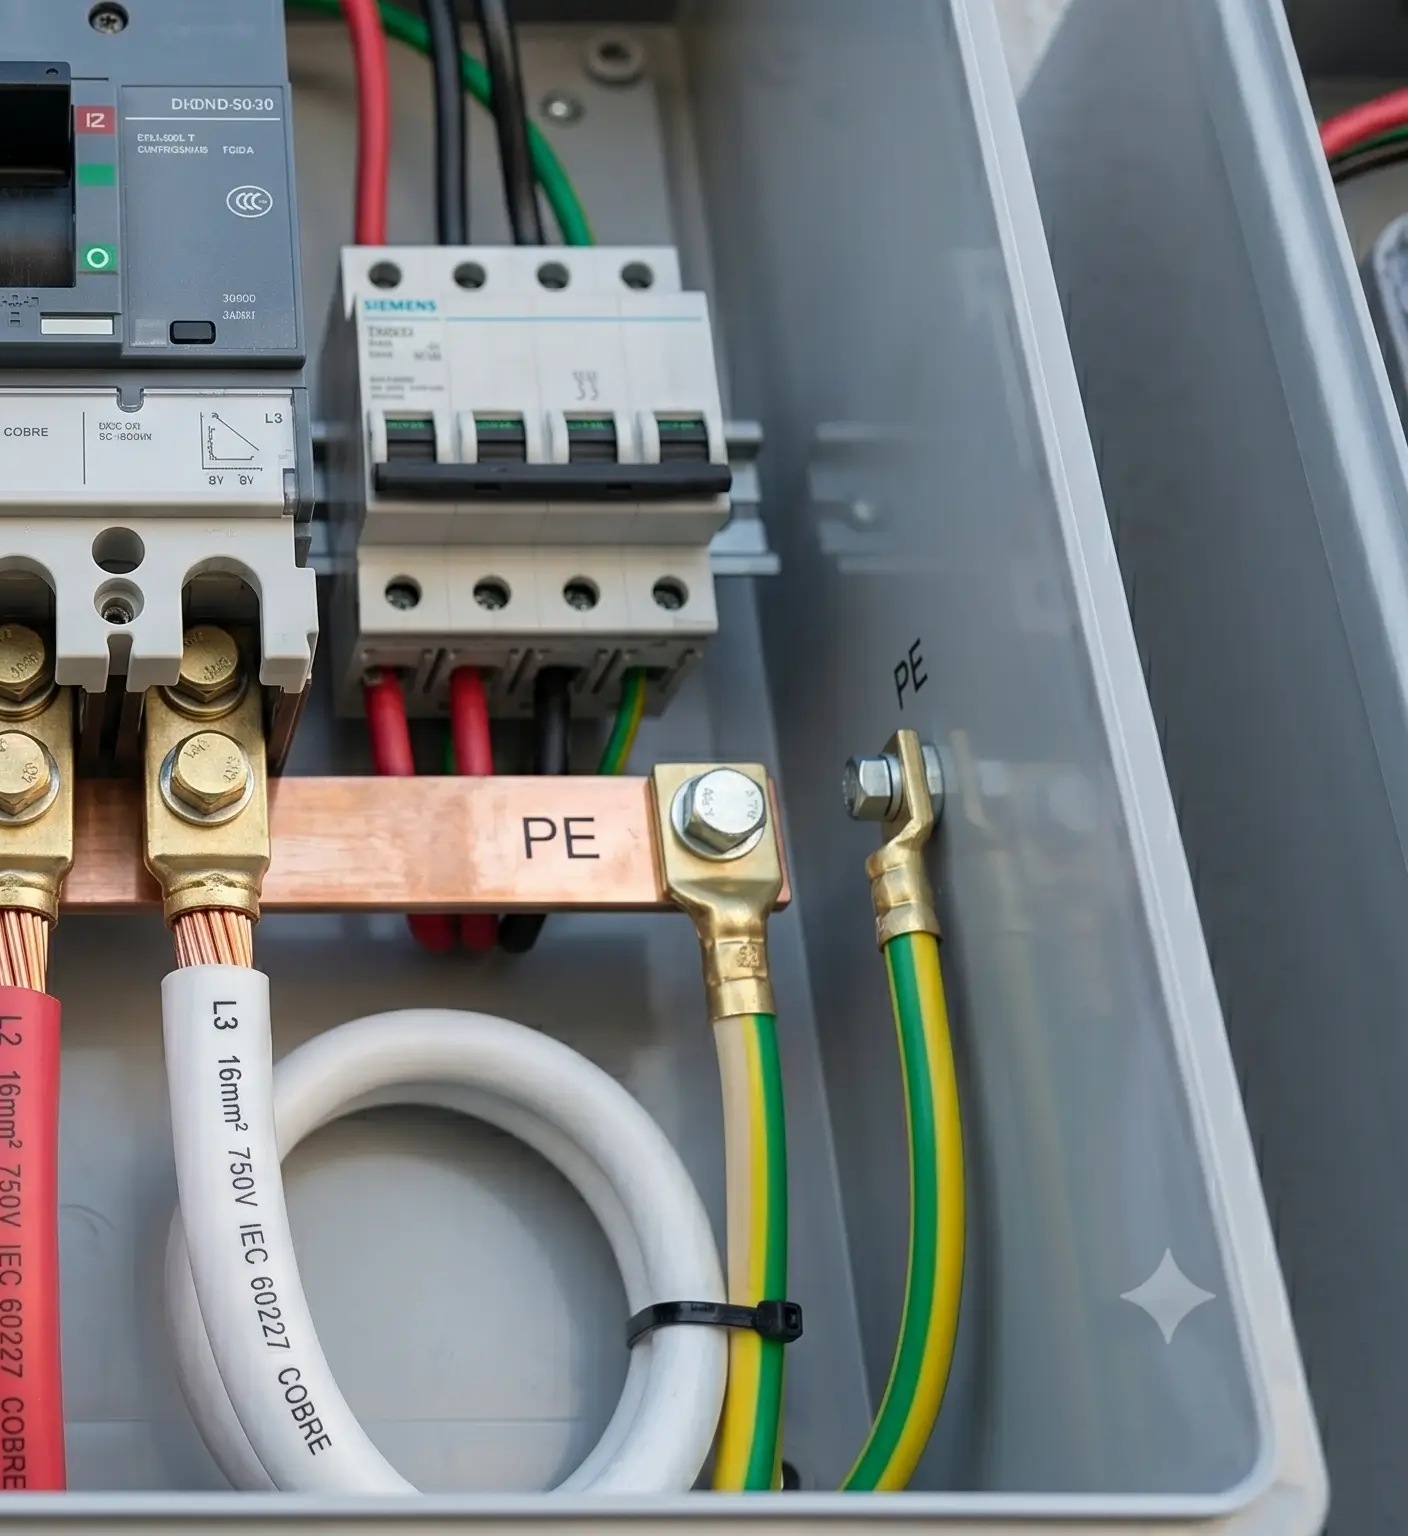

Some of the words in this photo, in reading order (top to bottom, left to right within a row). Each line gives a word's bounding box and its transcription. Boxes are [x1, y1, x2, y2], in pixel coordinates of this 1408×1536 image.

[363, 299, 437, 312] SIEMENS
[3, 427, 49, 437] COBRE
[265, 412, 283, 424] L3
[893, 637, 928, 711] PE
[522, 817, 600, 859] PE
[212, 1000, 239, 1030] L3
[228, 1146, 259, 1207] 750V
[239, 1223, 269, 1265] IEC
[250, 1276, 291, 1350] 60227
[278, 1367, 333, 1456] COBRE
[0, 1396, 26, 1490] COBRE
